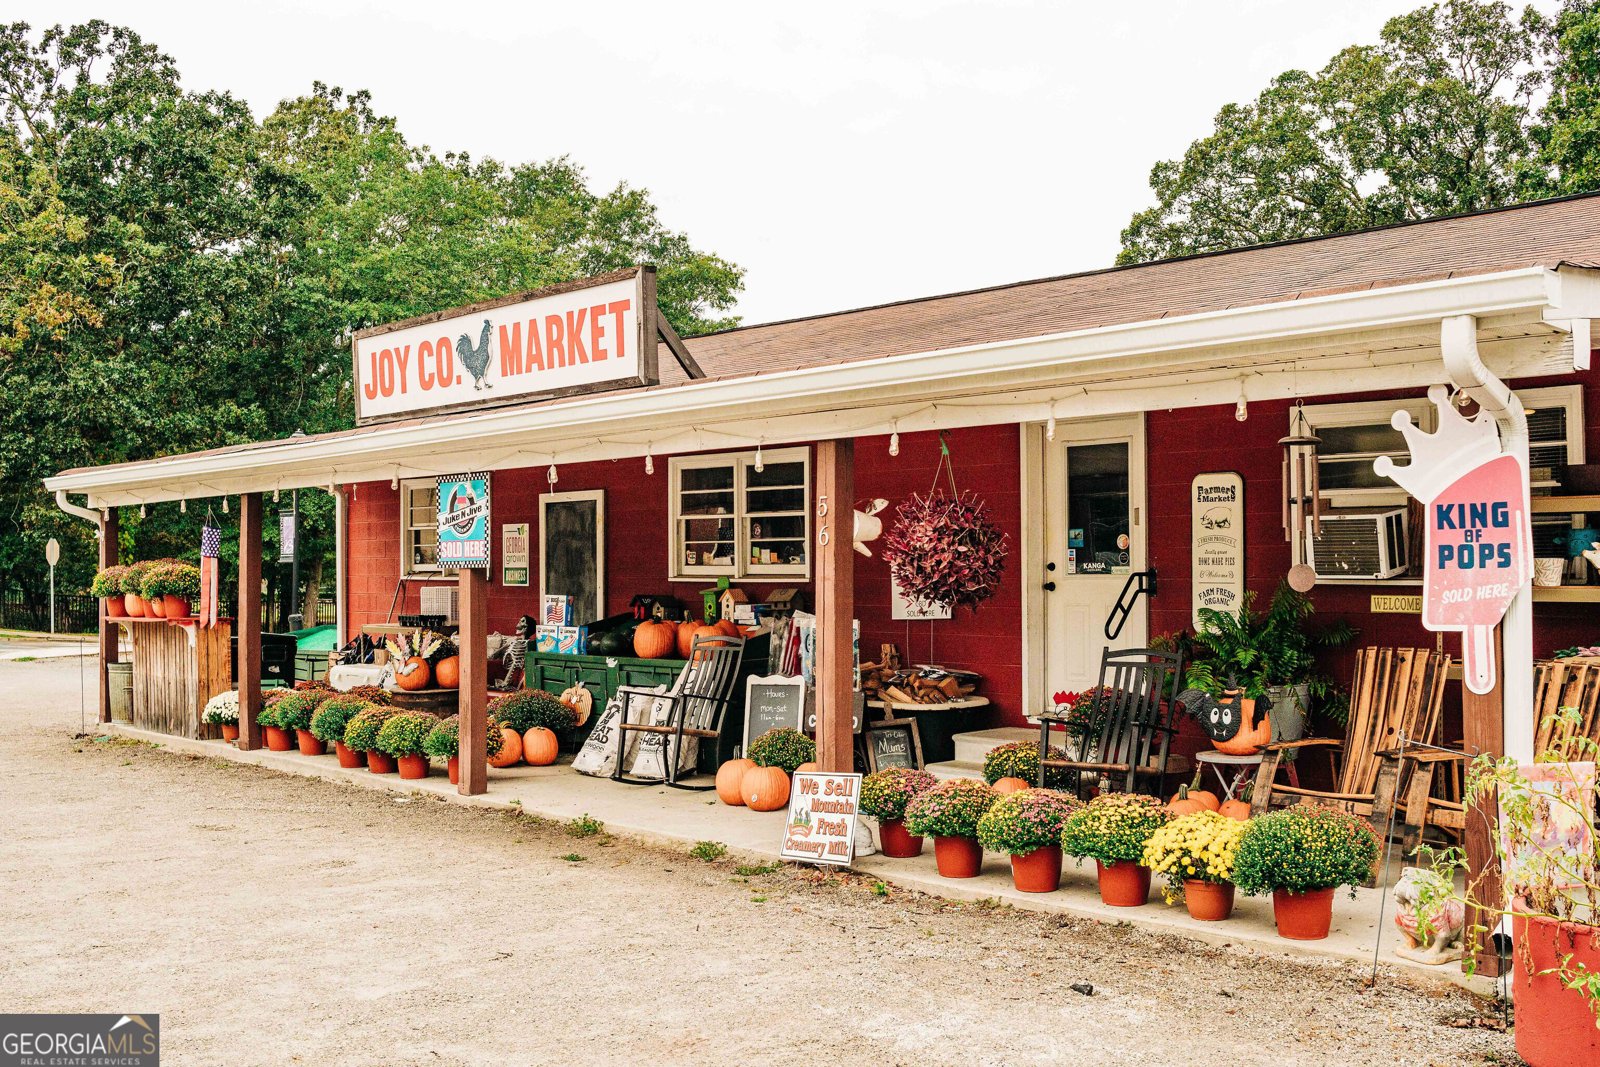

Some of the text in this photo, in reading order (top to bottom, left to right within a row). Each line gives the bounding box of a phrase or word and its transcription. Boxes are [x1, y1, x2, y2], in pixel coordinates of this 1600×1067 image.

[364, 299, 631, 400] JOY CO. MARKET
[442, 504, 483, 526] Juke N Jive
[1436, 502, 1510, 530] KING
[1464, 529, 1482, 543] OF
[441, 540, 486, 558] SOLD HERE
[506, 537, 526, 554] GEORGIA
[506, 555, 526, 565] grown
[1438, 543, 1512, 570] POPS
[505, 569, 526, 582] BUSINESS
[1198, 587, 1236, 601] FARM FRESH
[1204, 597, 1231, 606] ORGANIC
[1442, 583, 1510, 605] SOLD HERE
[1373, 597, 1421, 611] WELCOME
[878, 737, 906, 754] Mums
[799, 778, 854, 797] We Sell
[811, 797, 855, 815] Mountain
[816, 818, 848, 837] Fresh
[785, 837, 849, 858] Creamery Milk
